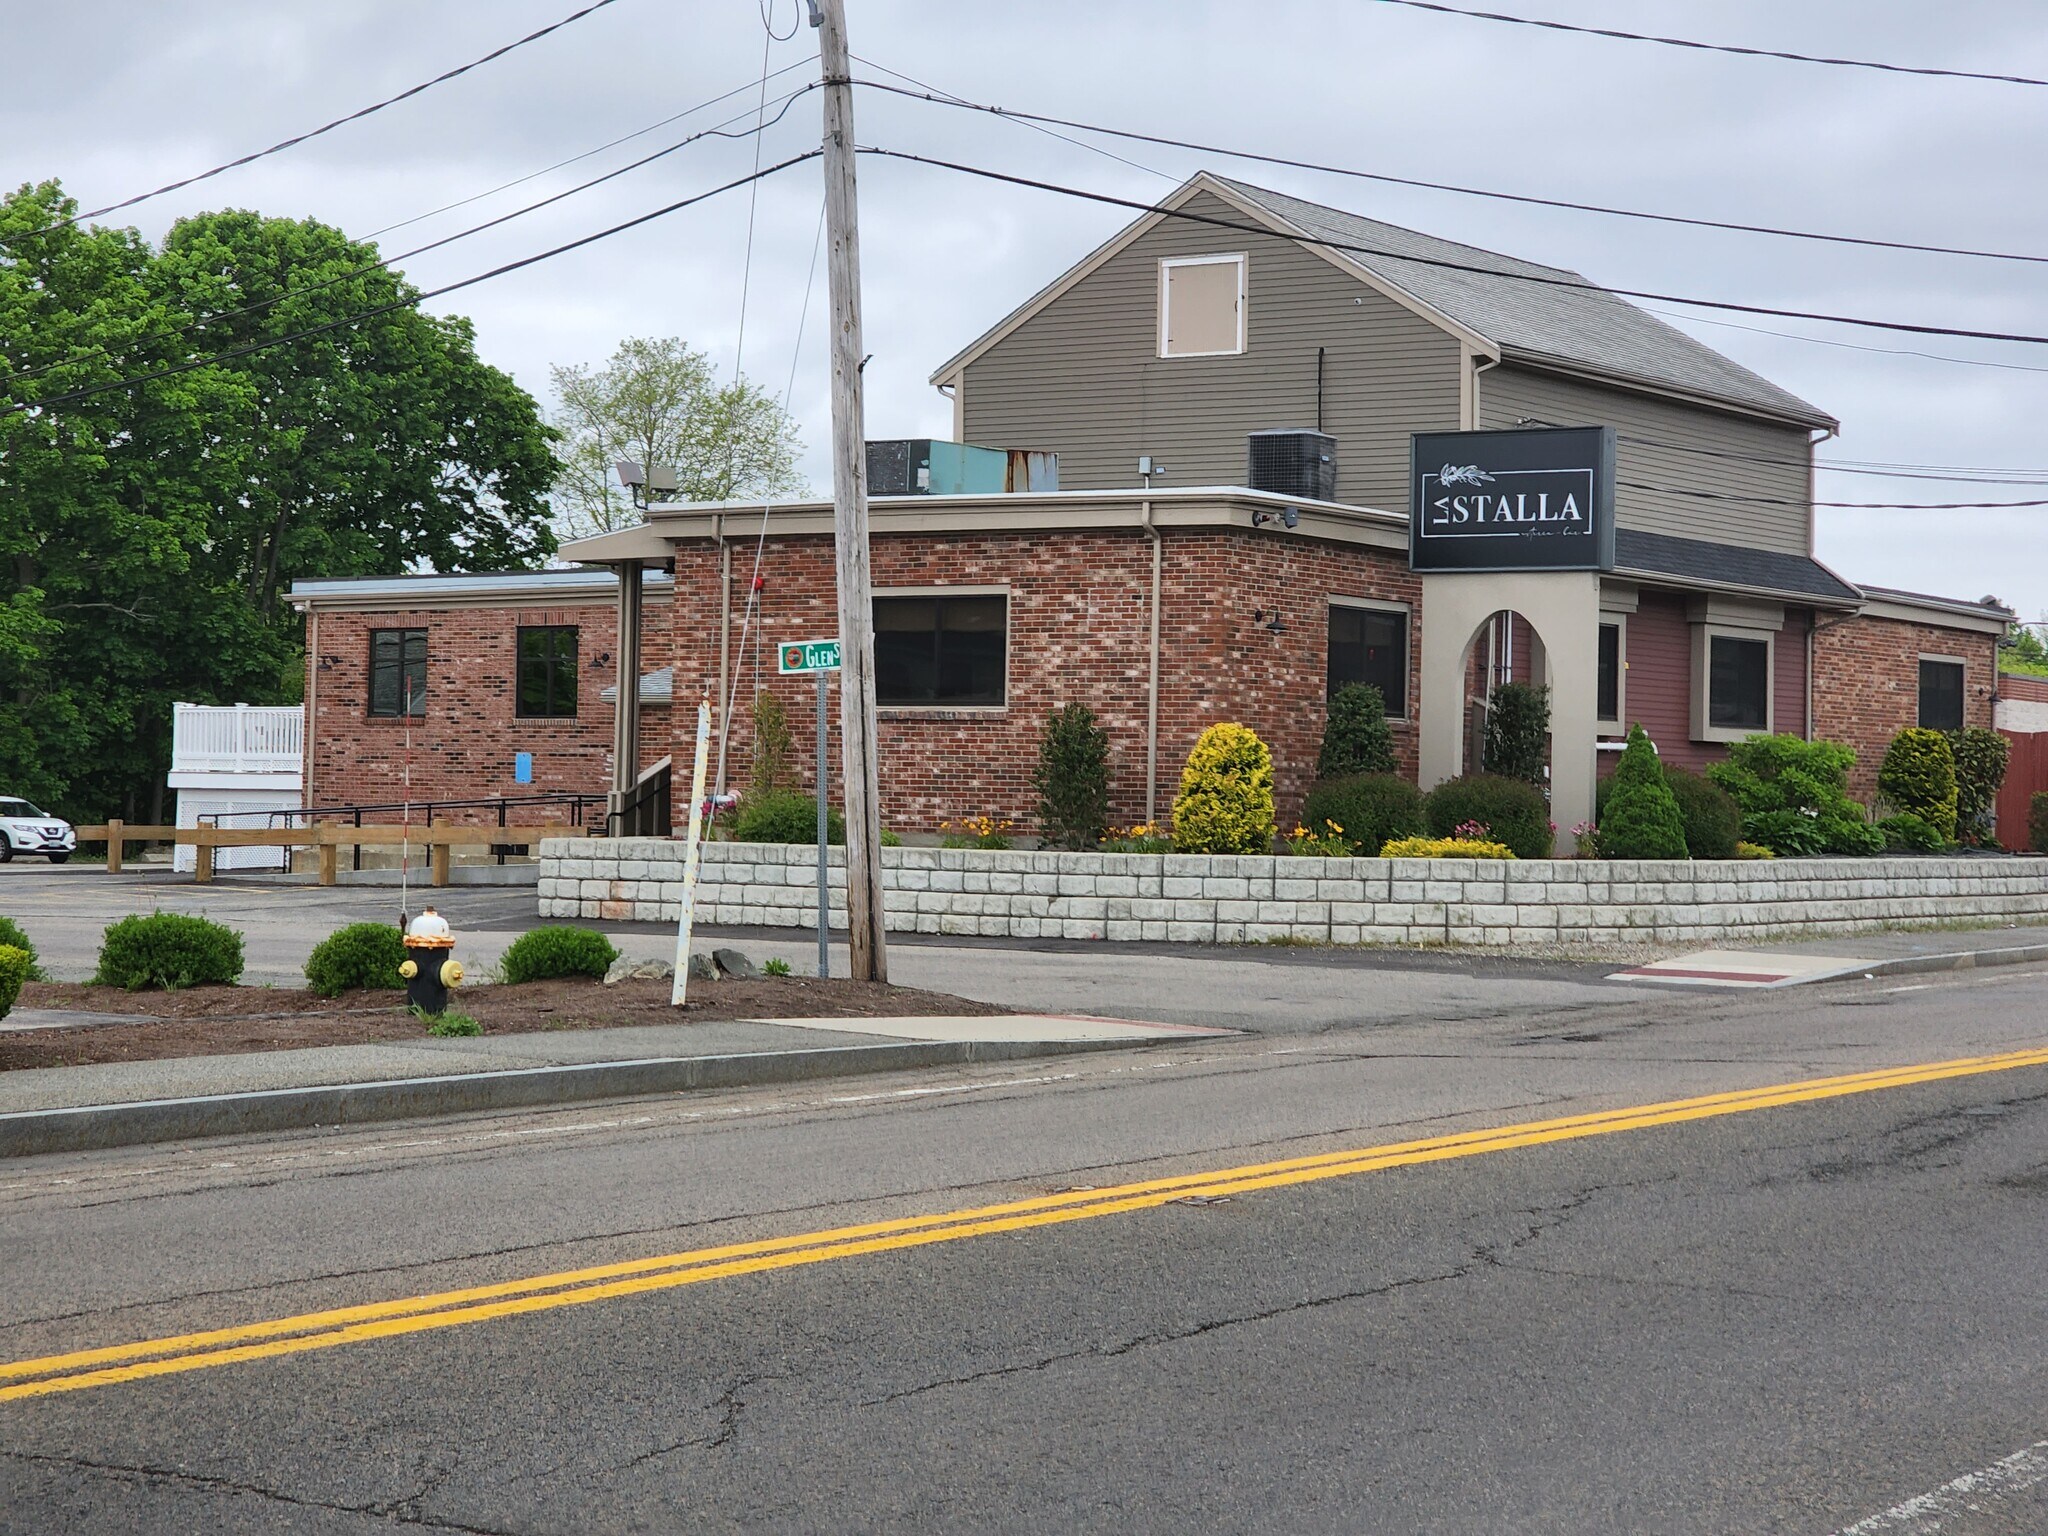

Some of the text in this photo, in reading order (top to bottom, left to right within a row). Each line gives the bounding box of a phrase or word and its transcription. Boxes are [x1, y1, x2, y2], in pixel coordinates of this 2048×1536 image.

[1433, 492, 1583, 525] LA STALLA
[805, 645, 834, 667] GLEN
